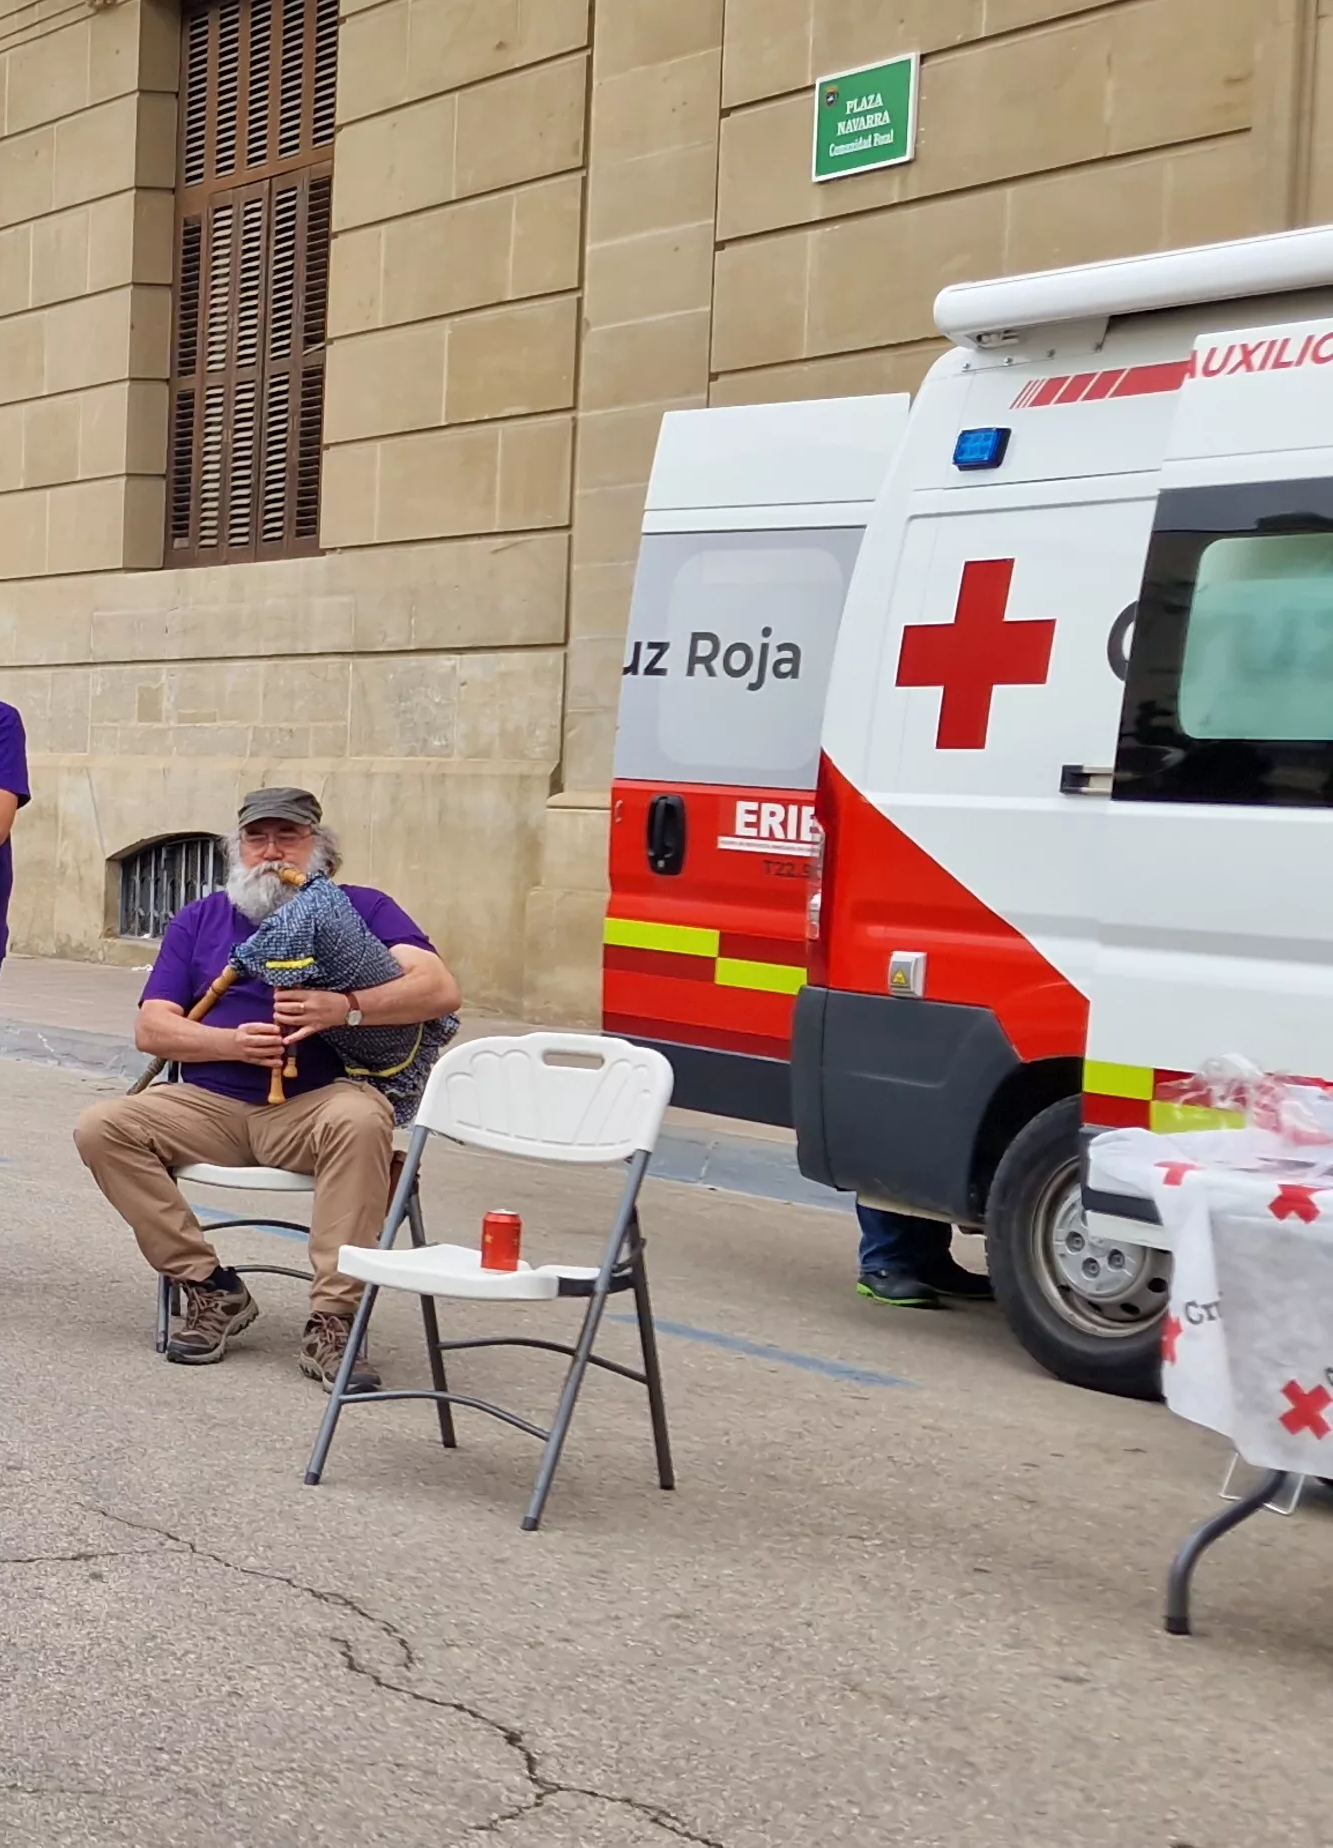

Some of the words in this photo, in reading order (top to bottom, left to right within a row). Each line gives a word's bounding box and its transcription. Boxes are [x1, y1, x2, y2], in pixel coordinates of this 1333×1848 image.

[845, 93, 883, 115] PLAZA
[836, 110, 891, 137] NAVARRA
[829, 134, 872, 158] Comunidad
[873, 129, 894, 147] Foral
[686, 626, 802, 691] Roja
